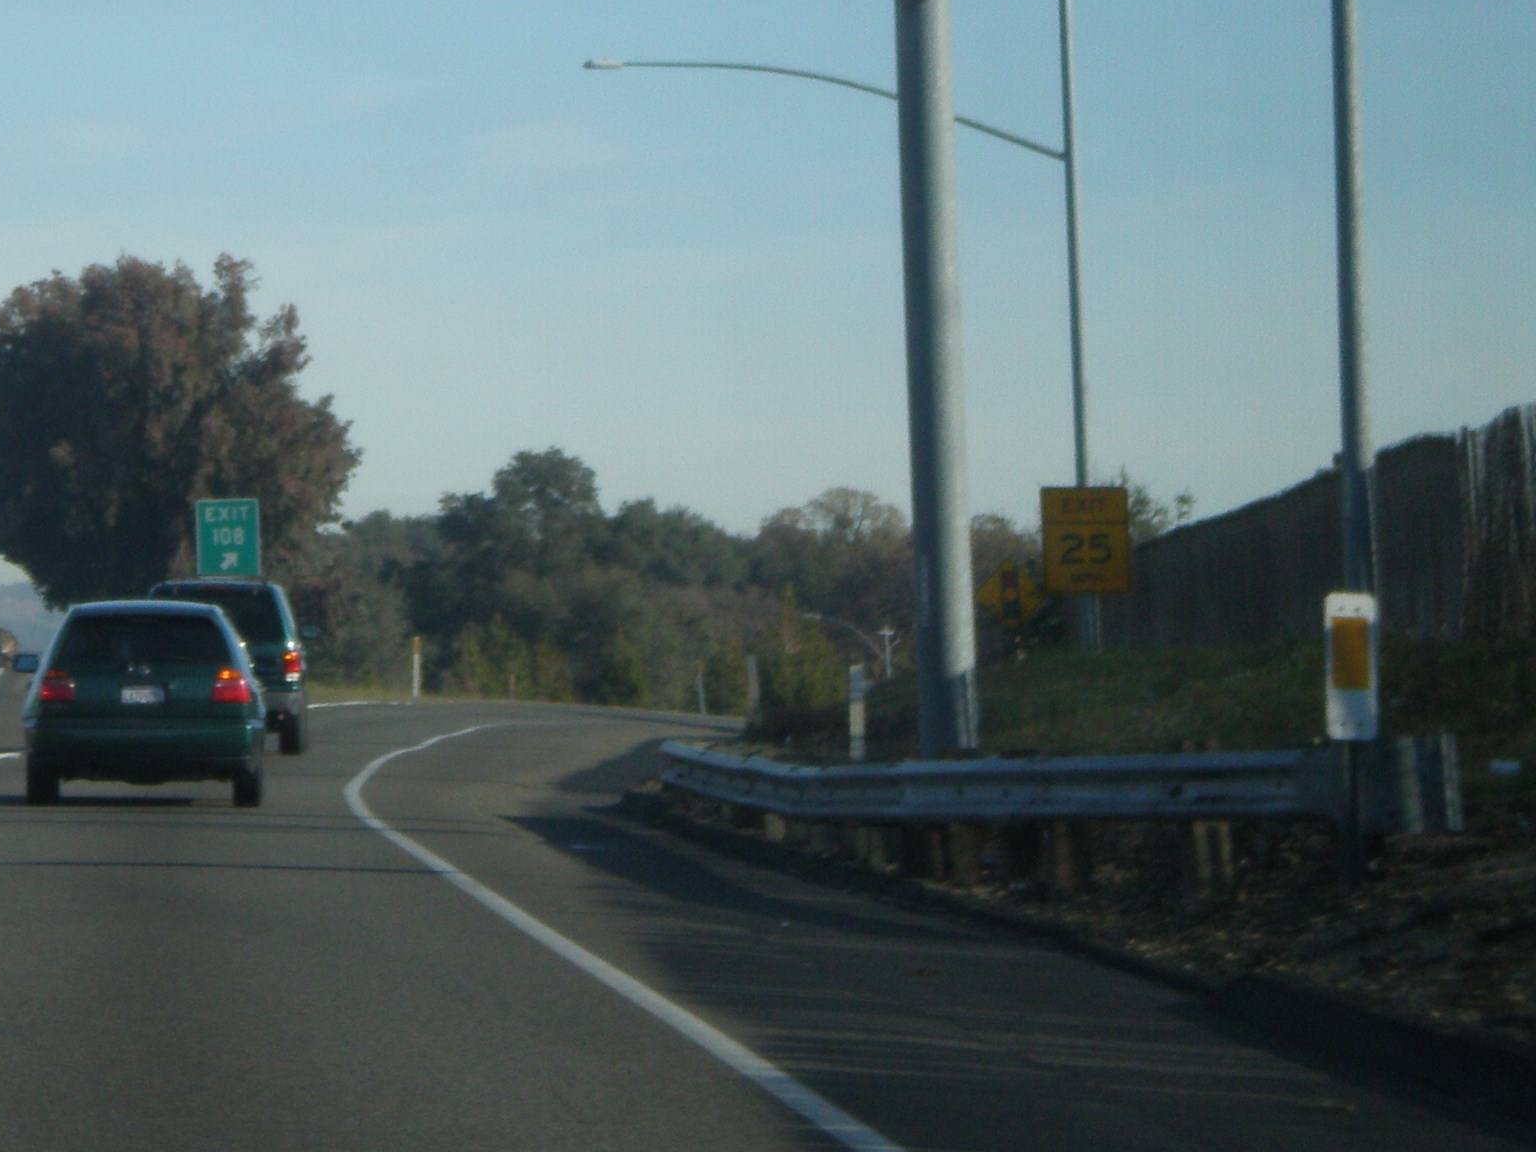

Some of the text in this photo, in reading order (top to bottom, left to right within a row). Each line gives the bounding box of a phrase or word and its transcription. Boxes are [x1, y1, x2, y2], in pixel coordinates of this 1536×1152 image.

[205, 506, 249, 522] EXIT
[212, 527, 245, 545] 108
[1059, 532, 1113, 564] 25
